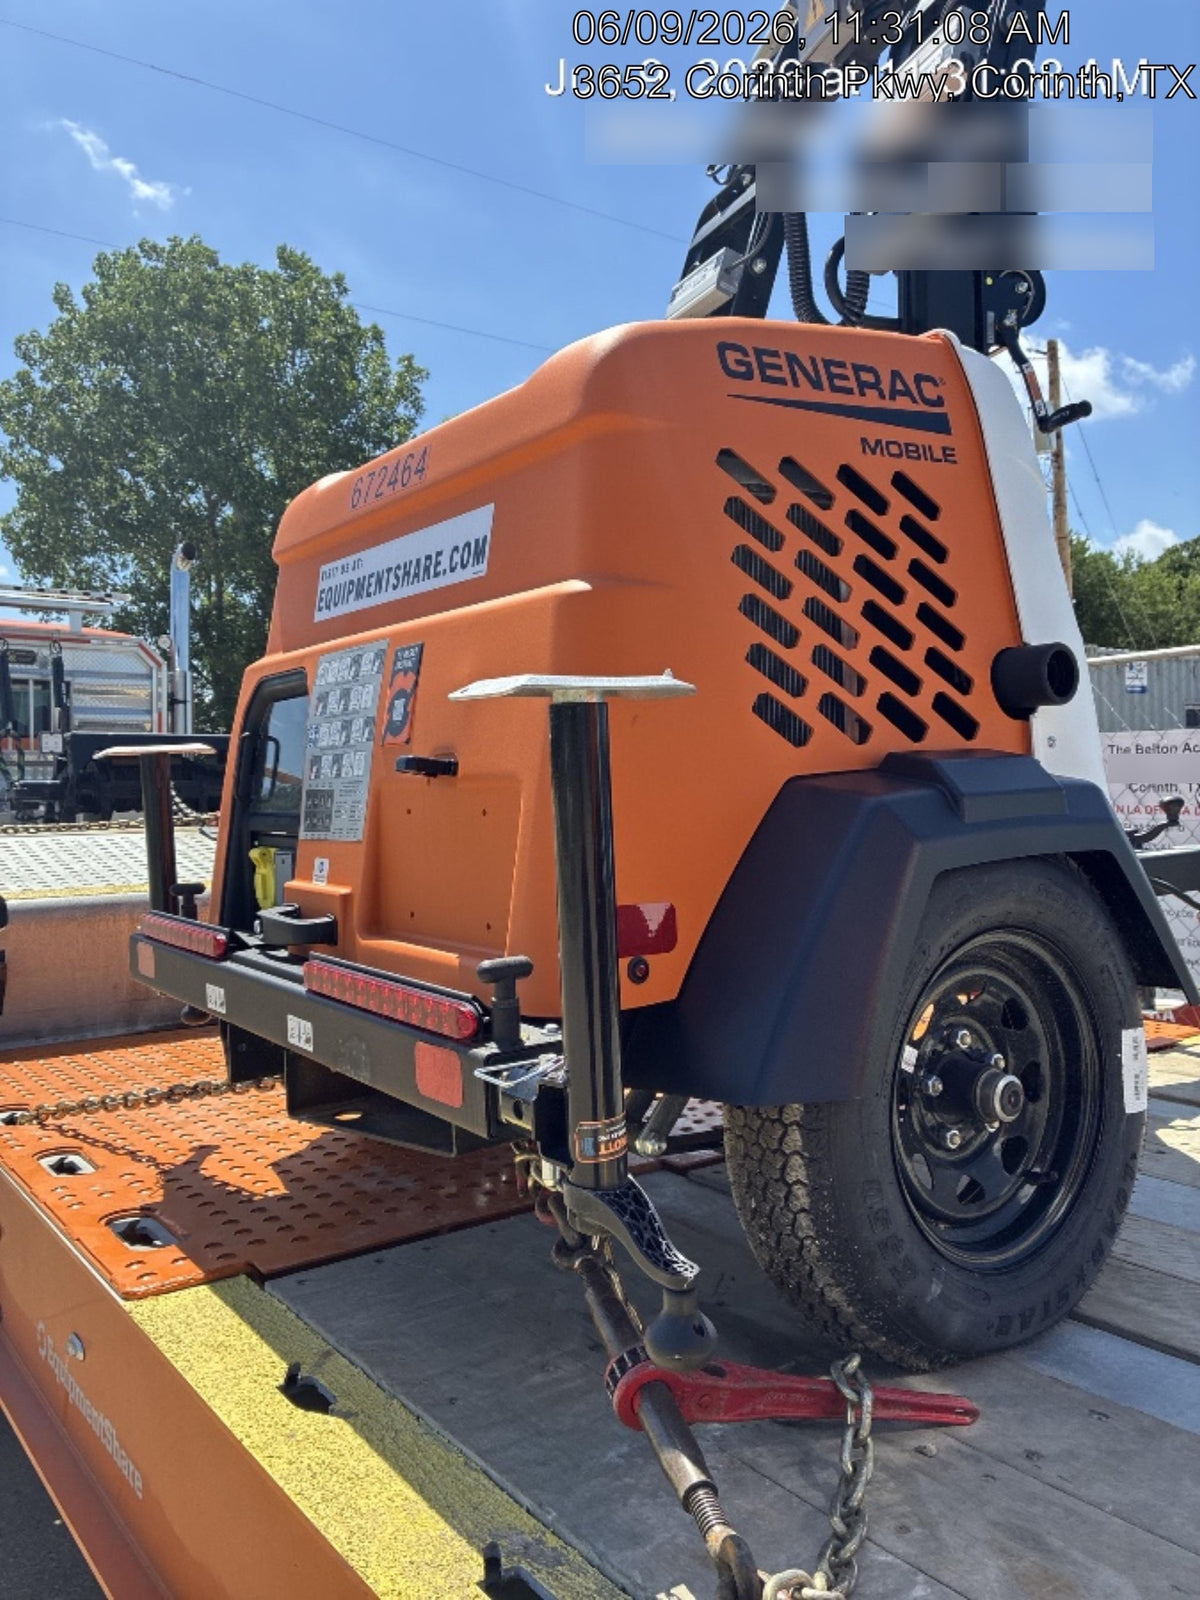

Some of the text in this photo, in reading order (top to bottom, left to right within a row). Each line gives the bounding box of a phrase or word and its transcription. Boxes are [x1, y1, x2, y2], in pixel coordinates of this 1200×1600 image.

[716, 341, 946, 408] GENERAC
[350, 443, 429, 510] 672464
[860, 437, 959, 465] MOBILE
[317, 534, 488, 612] EQUIPMENTSHARE.COM
[1107, 744, 1132, 754] The
[1135, 742, 1178, 755] Belton
